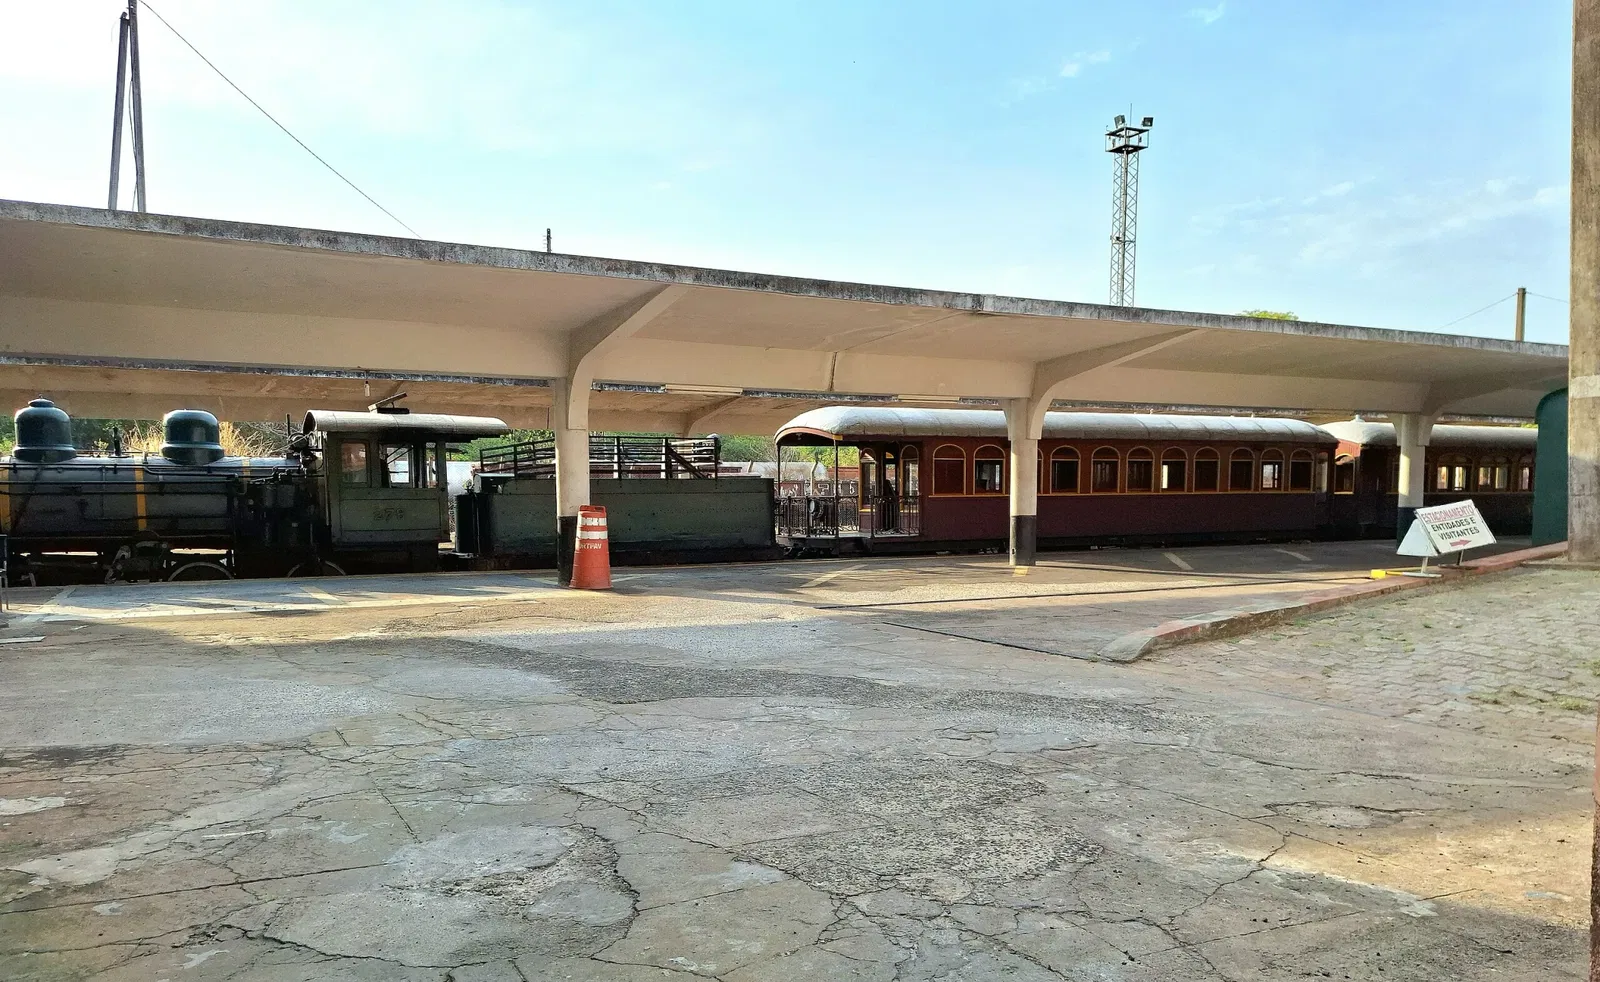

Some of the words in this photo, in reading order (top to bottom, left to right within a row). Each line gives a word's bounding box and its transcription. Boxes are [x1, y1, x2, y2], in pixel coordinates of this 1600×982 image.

[1421, 505, 1474, 522] ESTACIONAMENTO
[1431, 518, 1468, 532] ENTIDADES
[1439, 526, 1480, 540] VISITANTES
